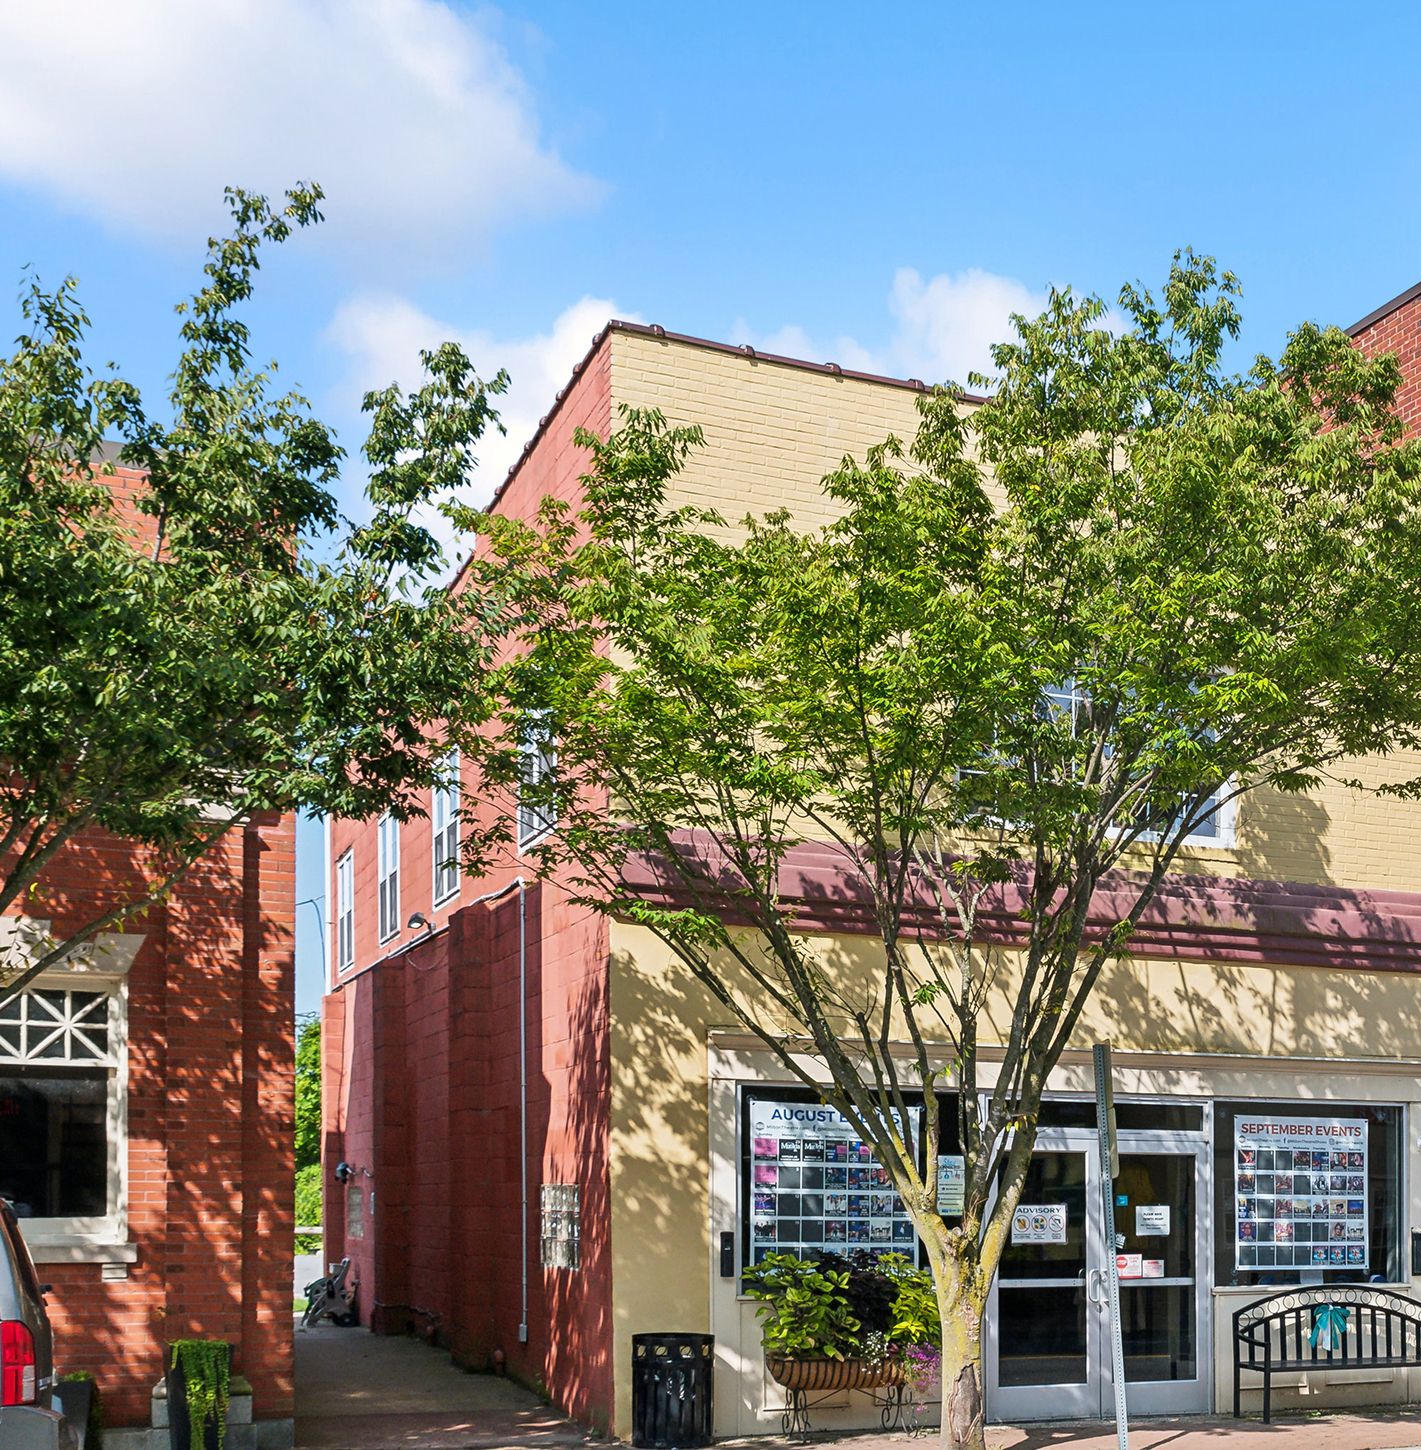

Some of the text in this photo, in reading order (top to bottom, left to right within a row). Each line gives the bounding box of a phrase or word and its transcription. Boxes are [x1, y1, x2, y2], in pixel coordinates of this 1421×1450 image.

[771, 1109, 835, 1122] AUGUST
[1241, 1123, 1362, 1136] SEPTEMBER EVENTS
